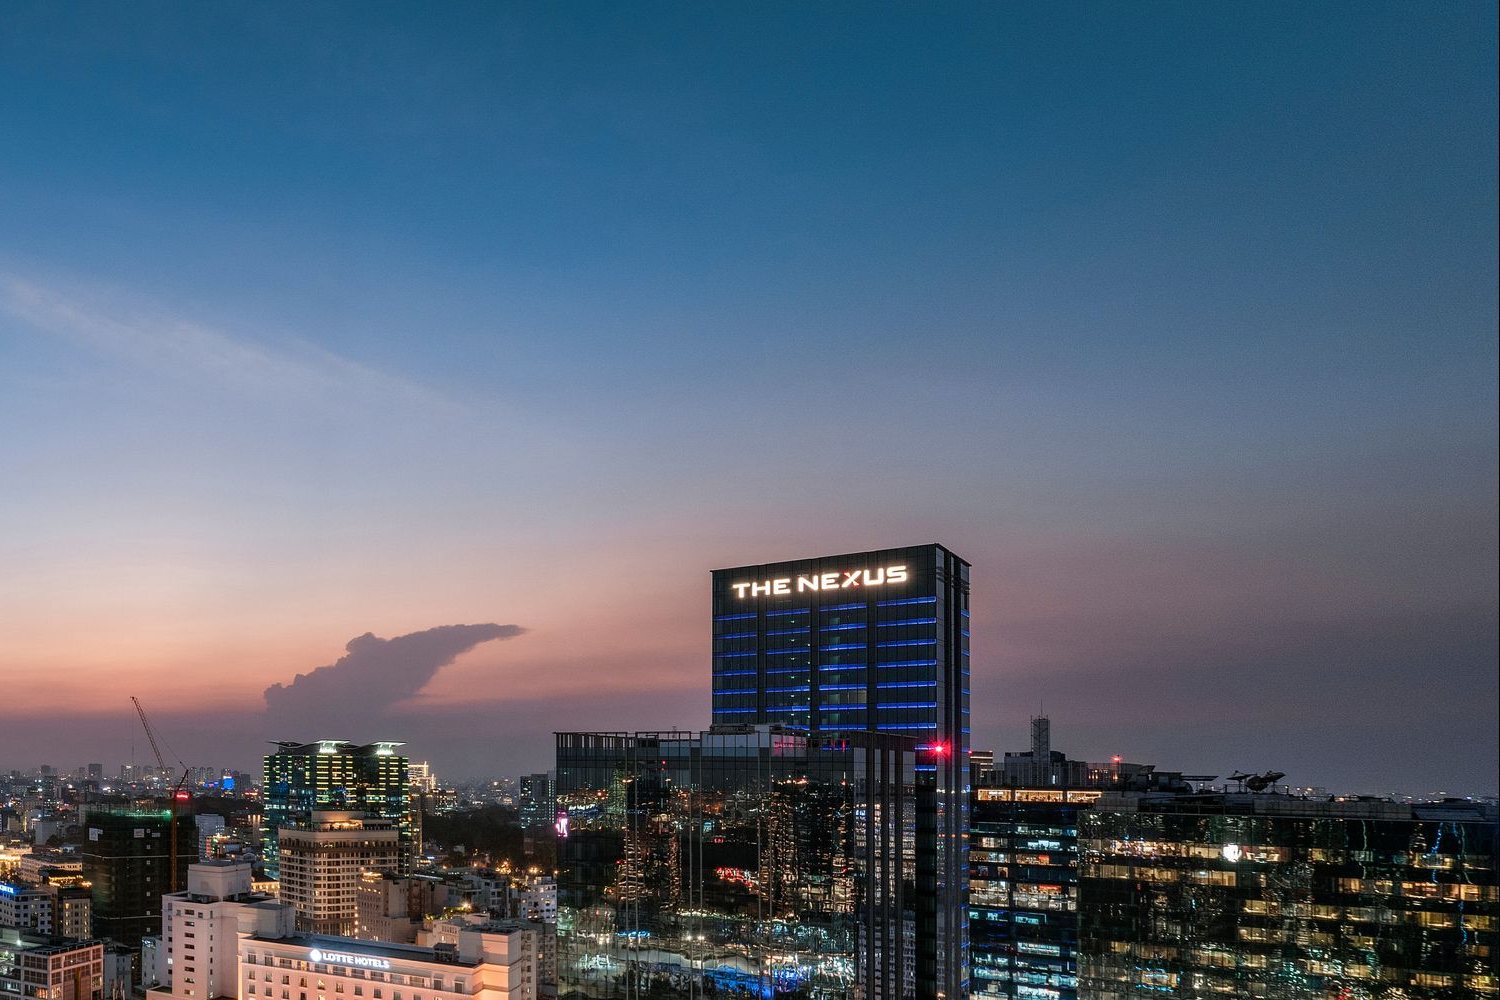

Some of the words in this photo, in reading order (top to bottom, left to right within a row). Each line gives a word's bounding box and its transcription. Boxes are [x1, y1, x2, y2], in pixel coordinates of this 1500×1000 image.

[732, 578, 791, 598] THE
[797, 565, 907, 593] NEXUS
[322, 952, 354, 964] LOTTE
[355, 956, 390, 969] HOTELS
